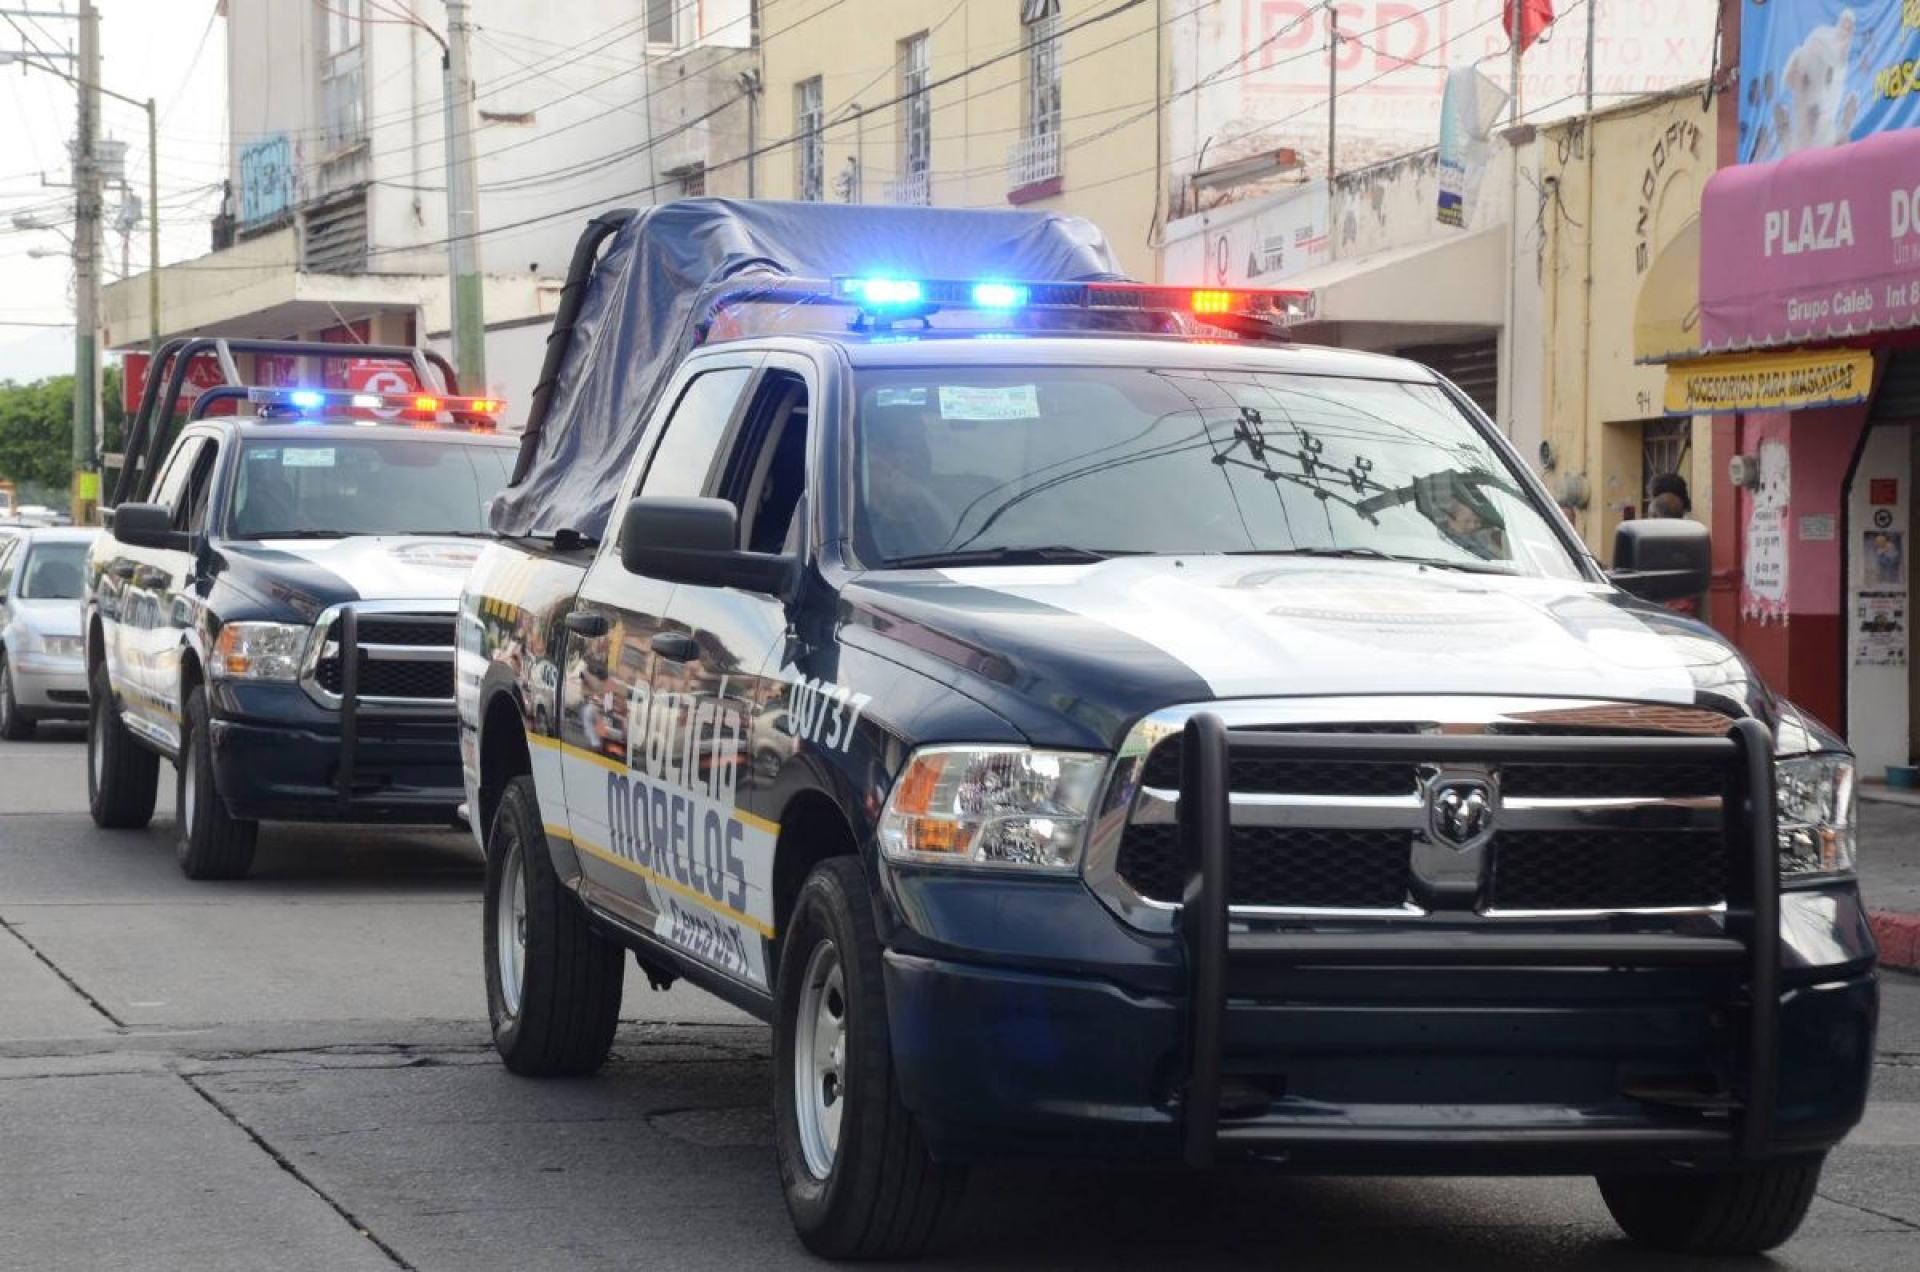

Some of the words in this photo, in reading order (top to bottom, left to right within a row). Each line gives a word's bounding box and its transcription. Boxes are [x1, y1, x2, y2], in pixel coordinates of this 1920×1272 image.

[1260, 2, 1429, 72] PSD
[1764, 199, 1855, 257] PLAZA
[1787, 298, 1829, 323] Grupo
[1832, 287, 1873, 315] Caleb
[1887, 285, 1906, 307] Int
[788, 673, 873, 752] 00737
[608, 770, 746, 914] MORELOS
